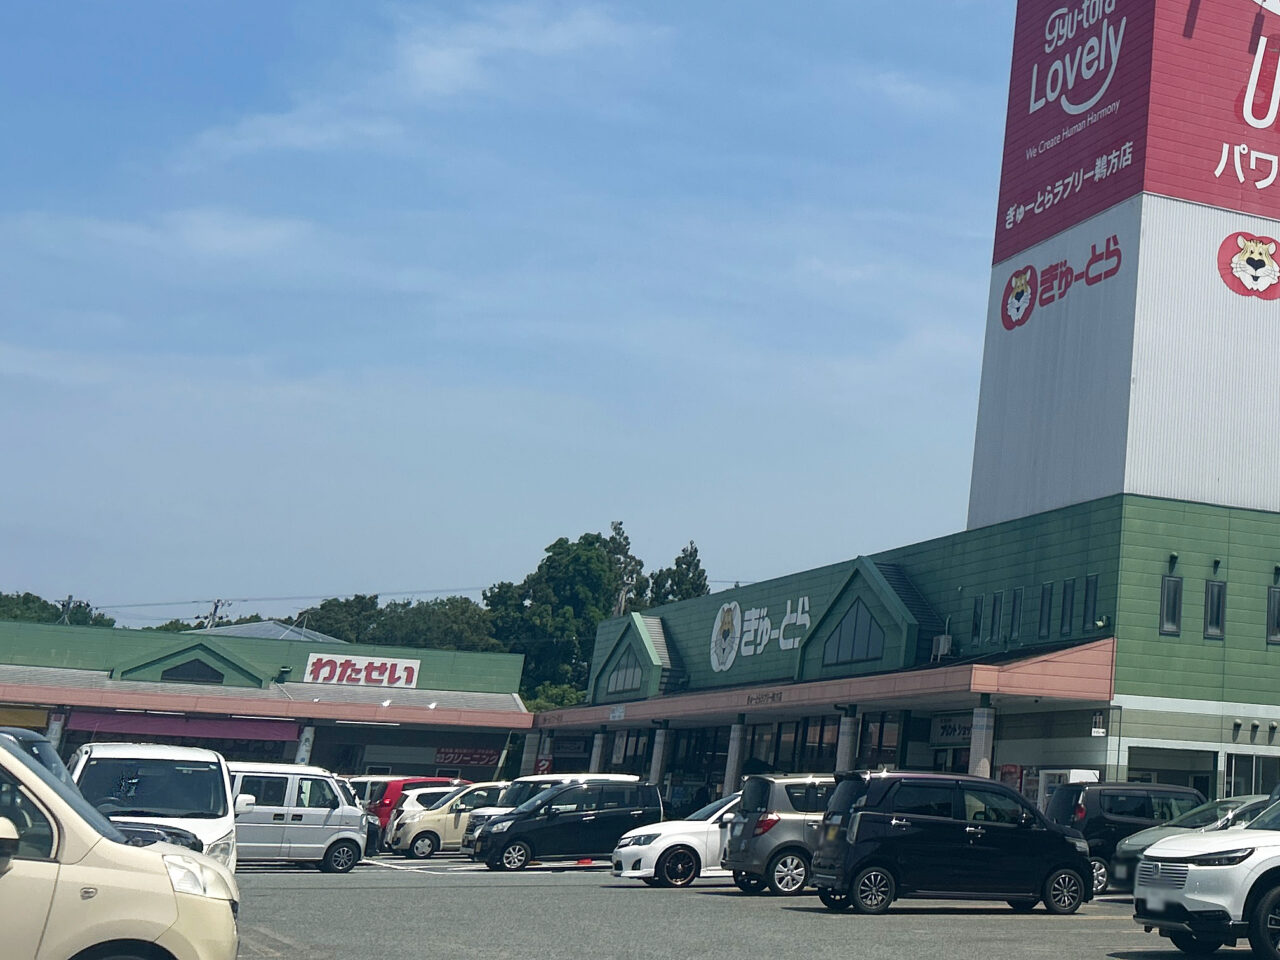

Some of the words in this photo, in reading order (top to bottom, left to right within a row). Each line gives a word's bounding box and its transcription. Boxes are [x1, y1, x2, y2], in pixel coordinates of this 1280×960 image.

[1029, 16, 1127, 115] Lovely
[1026, 146, 1037, 160] We
[1038, 134, 1061, 153] Create
[1062, 119, 1086, 141] Human
[1087, 100, 1120, 126] Harmony
[1005, 141, 1133, 229] ぎゅーとらラブリー鵜方店
[1038, 234, 1122, 307] ぎゅーとら
[741, 596, 810, 656] ぎゅーとら
[310, 658, 414, 685] わたせい
